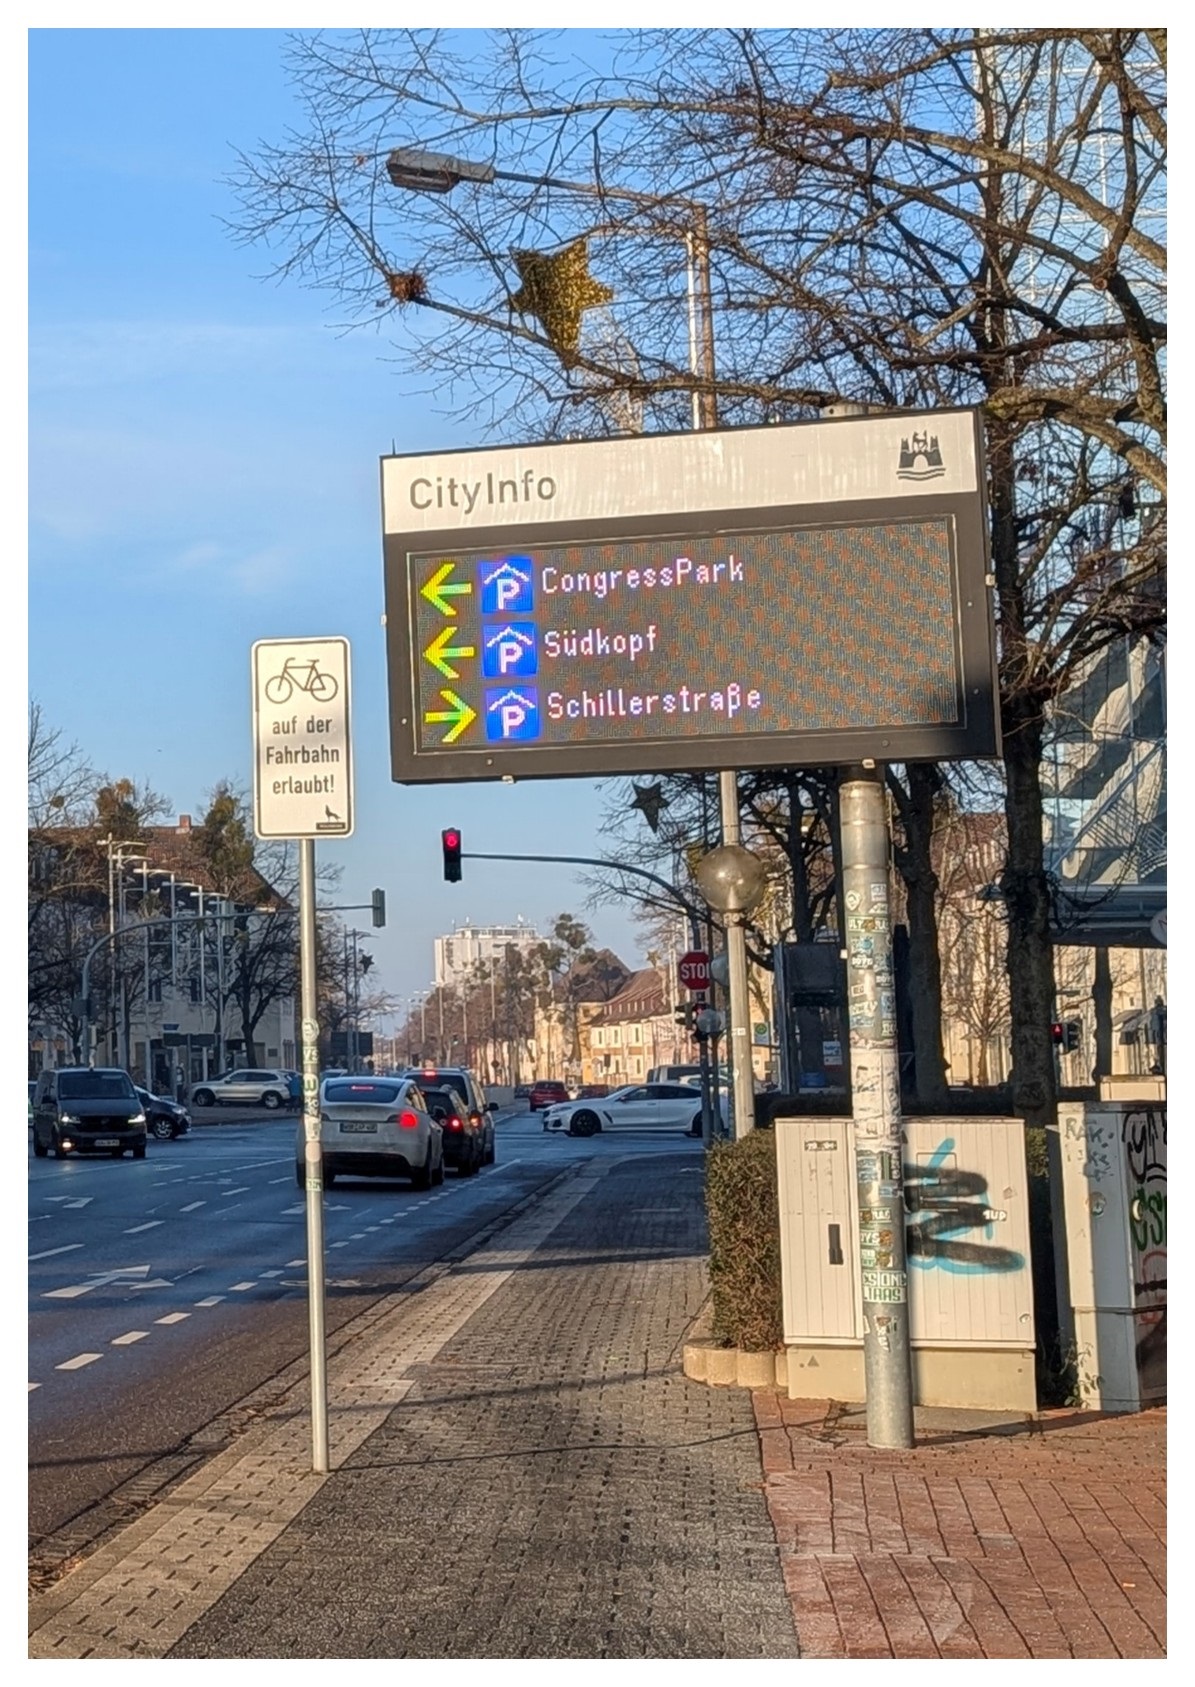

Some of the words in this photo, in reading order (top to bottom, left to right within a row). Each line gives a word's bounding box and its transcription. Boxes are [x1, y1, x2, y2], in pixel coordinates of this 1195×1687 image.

[409, 470, 557, 514] CityInfo
[541, 555, 745, 598] CongressPark
[543, 625, 658, 661] Südkopf
[547, 683, 762, 719] Schillerstraße
[272, 715, 298, 735] auf
[306, 715, 332, 734] der
[266, 744, 340, 765] Fahrbahn
[272, 774, 335, 794] erlaubt!
